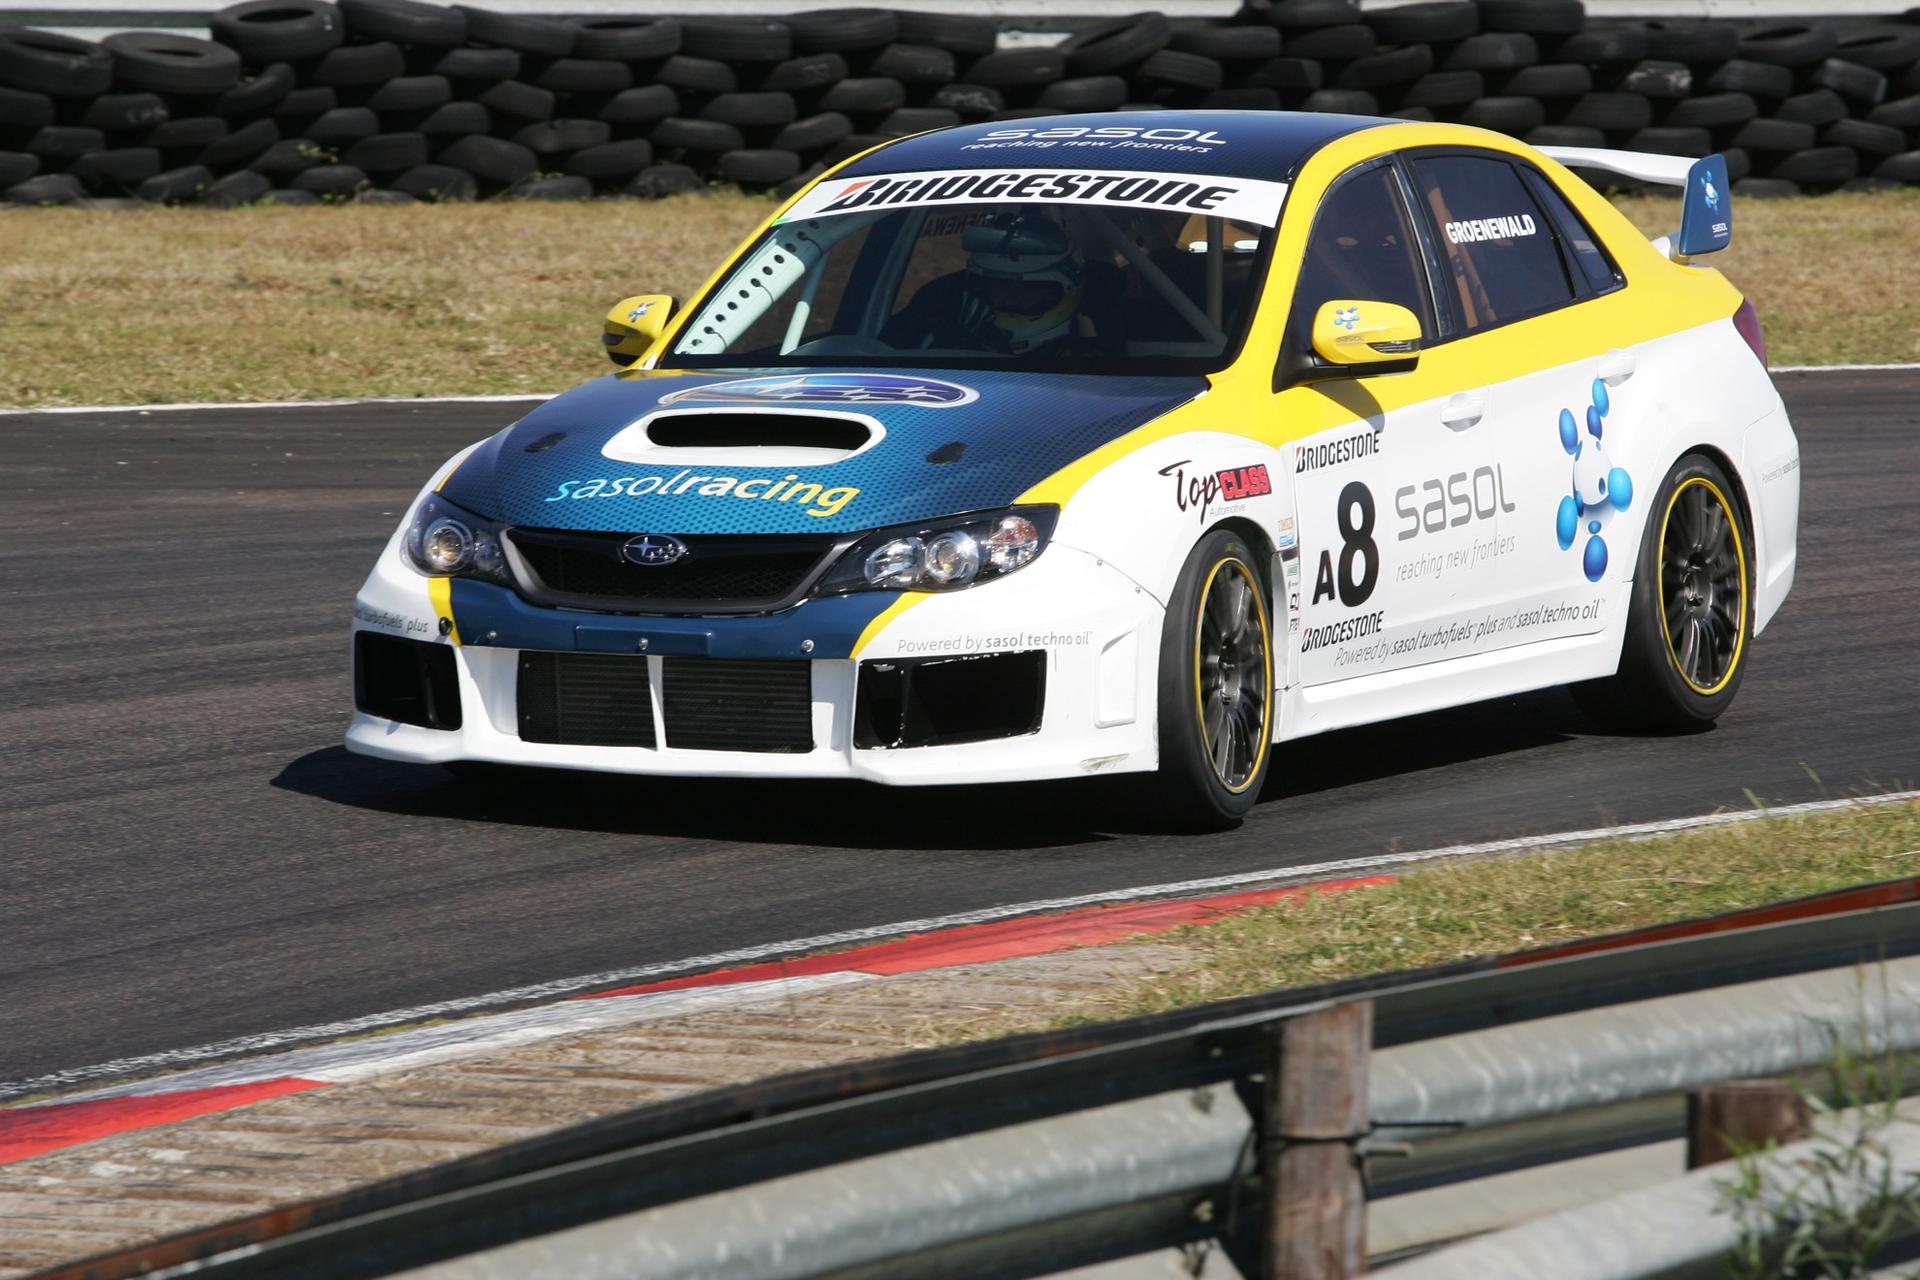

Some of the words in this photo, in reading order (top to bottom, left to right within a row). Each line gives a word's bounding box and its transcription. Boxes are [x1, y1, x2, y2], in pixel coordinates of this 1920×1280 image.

[960, 138, 1058, 151] reaching
[1062, 139, 1113, 149] new
[1110, 139, 1213, 154] frontiers
[816, 172, 1239, 214] BRIDGESTONE
[1445, 214, 1536, 244] GROENEWALD
[1295, 429, 1380, 473] BRIDGESTONE
[545, 469, 861, 517] sasolracing
[1396, 552, 1443, 582] reaching
[1446, 547, 1469, 569] new
[1471, 535, 1516, 569] frontiers
[406, 617, 429, 634] plus
[898, 635, 961, 653] Powered
[965, 635, 983, 653] by
[985, 632, 1023, 648] sasol
[1027, 631, 1073, 647] techno
[1301, 610, 1384, 653] BRIDGESTONE
[1334, 640, 1380, 667] Powered
[1379, 638, 1393, 663] by
[1391, 630, 1420, 655] sasol
[1474, 615, 1498, 643] plus
[1498, 608, 1520, 632] and
[1516, 604, 1544, 628] sasol
[1542, 601, 1580, 624] techno
